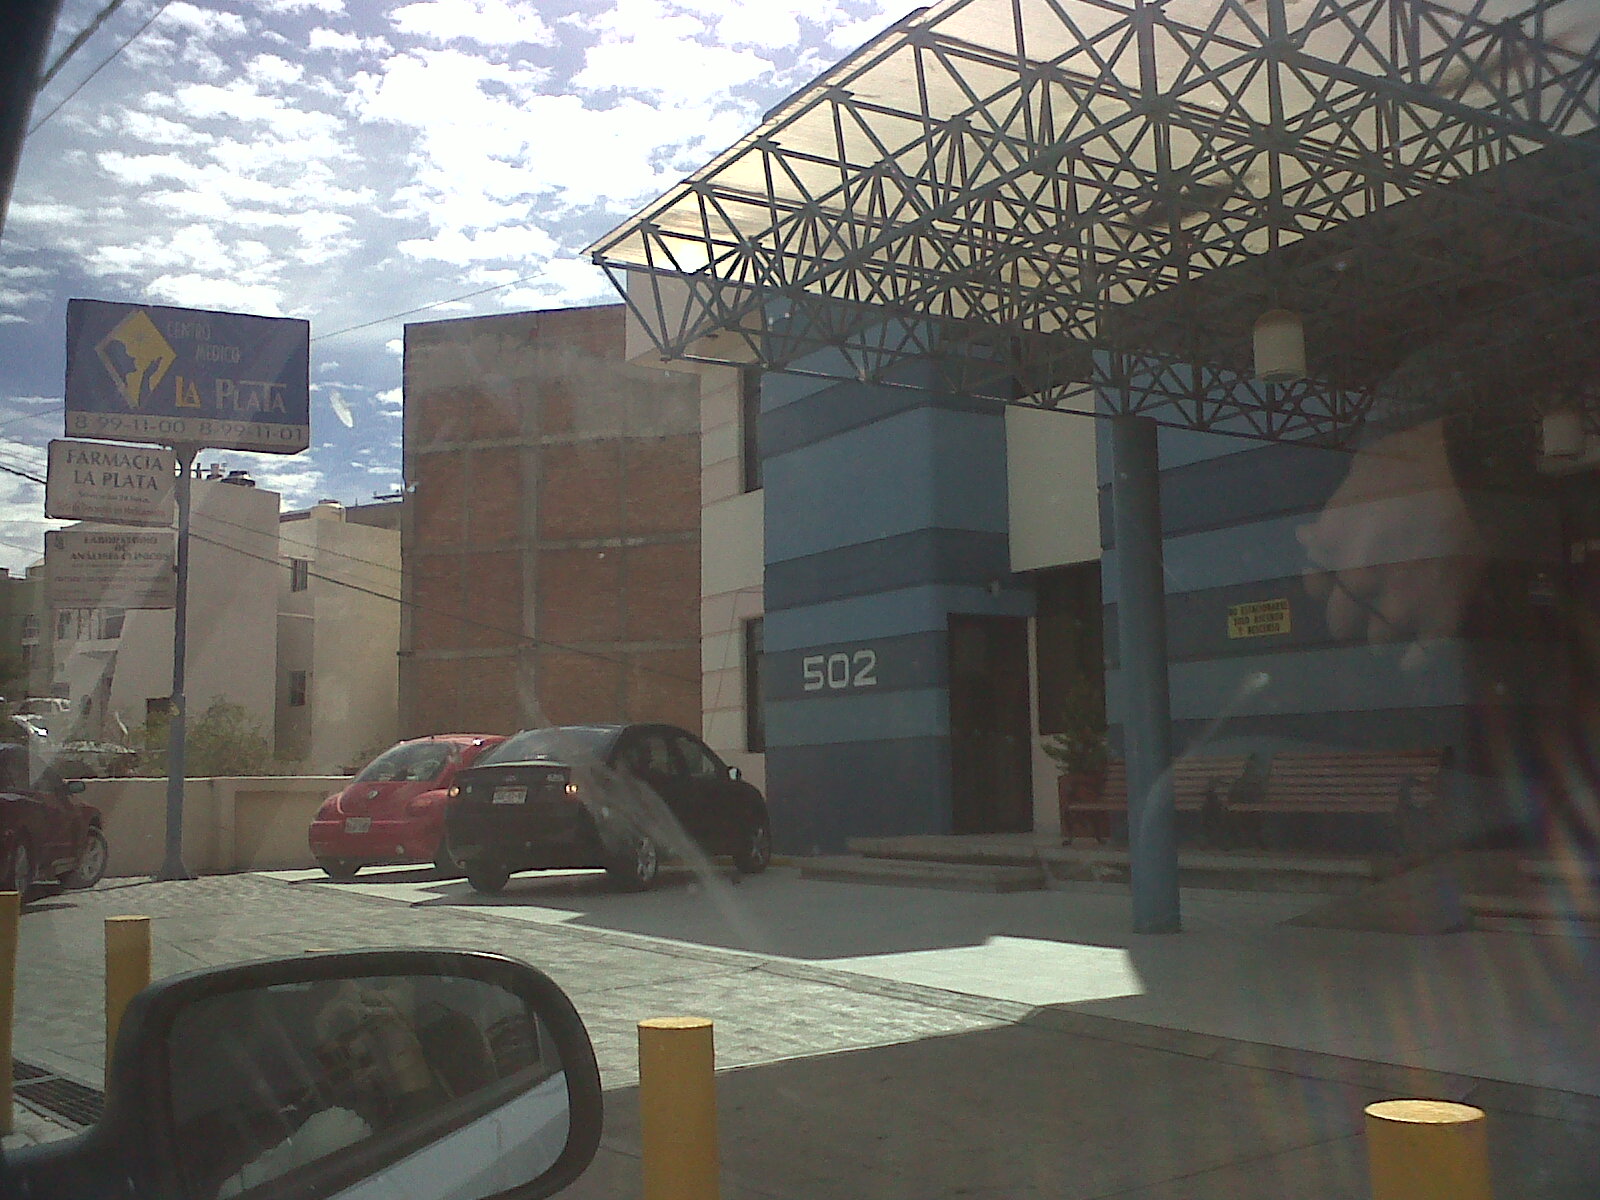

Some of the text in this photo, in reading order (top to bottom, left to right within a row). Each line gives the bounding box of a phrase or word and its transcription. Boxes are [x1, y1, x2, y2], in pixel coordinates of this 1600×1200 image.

[175, 376, 287, 414] LA PLATA
[66, 449, 162, 471] FARMACIA
[74, 470, 158, 490] LA PLATA
[803, 649, 877, 691] 502
